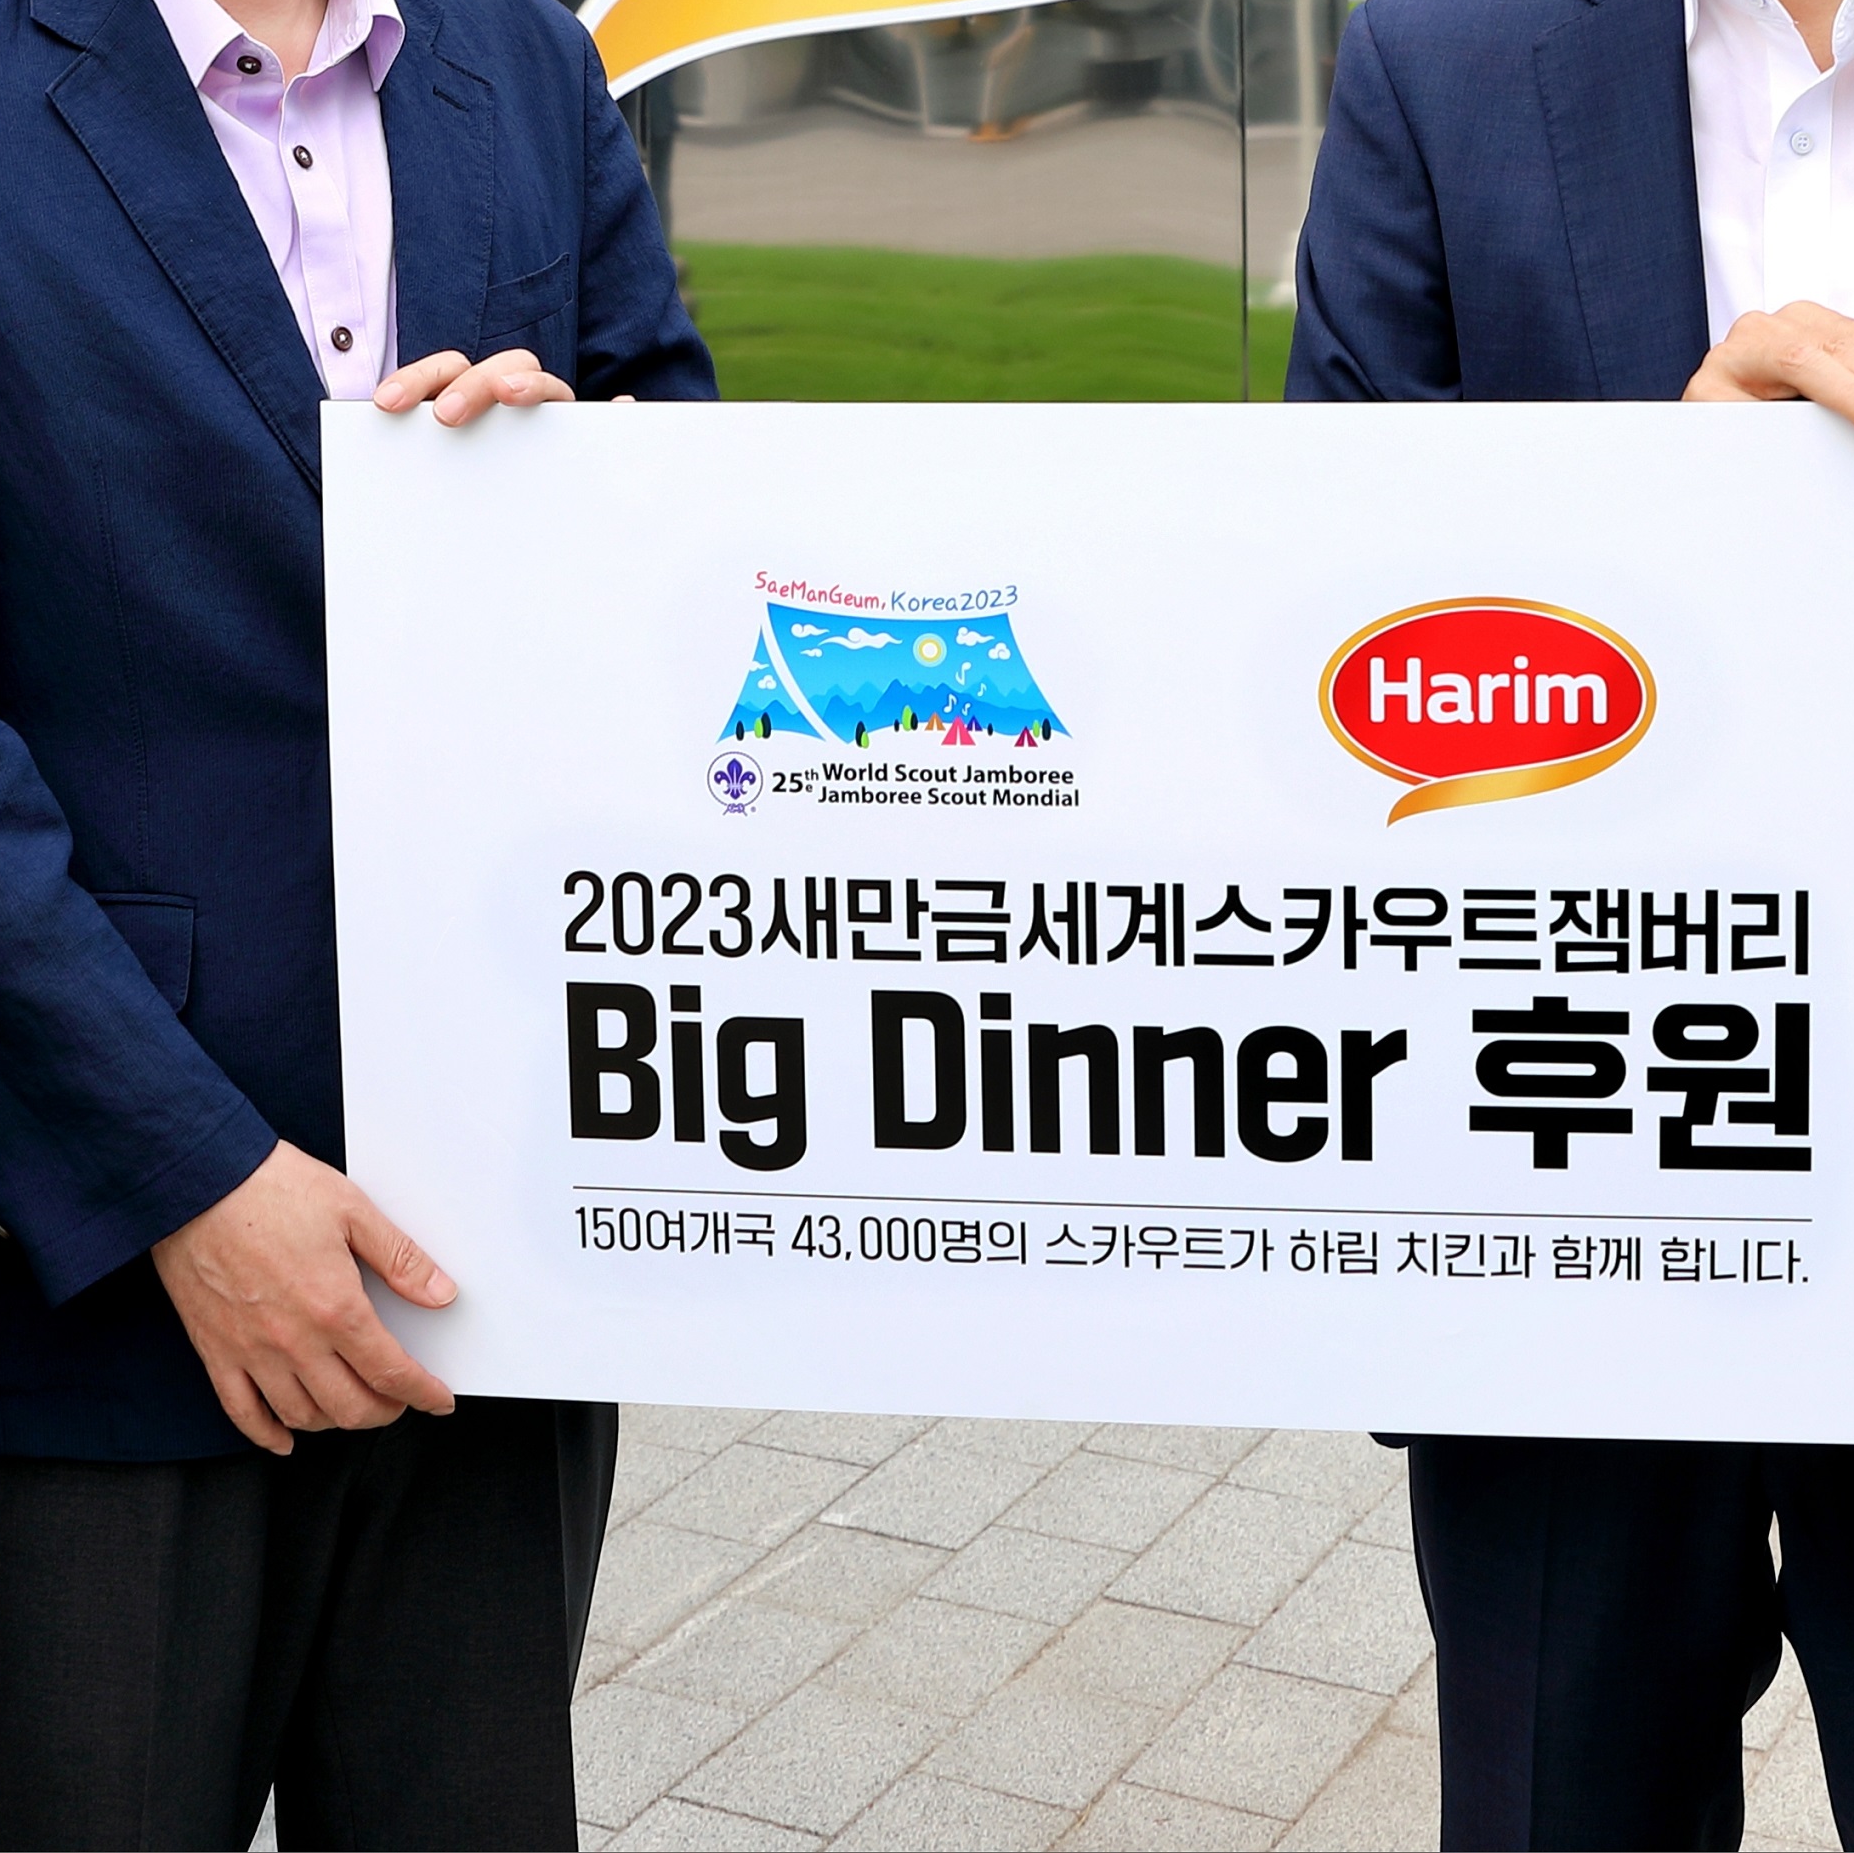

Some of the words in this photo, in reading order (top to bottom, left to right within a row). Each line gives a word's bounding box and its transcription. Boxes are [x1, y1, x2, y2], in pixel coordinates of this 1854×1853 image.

[1369, 655, 1608, 724] Harim
[818, 785, 922, 806] Jamboree
[927, 787, 988, 807] Scout
[992, 788, 1080, 808] Mondial
[821, 762, 888, 782] World
[894, 763, 958, 783] Scout
[962, 764, 1075, 786] Jamboree
[563, 870, 1809, 976] 2023새만금세계스카우트잼버리
[565, 981, 808, 1172] Big
[870, 989, 1408, 1164] Dinner
[1468, 995, 1813, 1172] 후원
[575, 1206, 776, 1257] 150여개국
[791, 1214, 1027, 1265] 43,000명의
[1045, 1223, 1275, 1272] 스카우트가
[1290, 1228, 1378, 1275] 하림
[1396, 1231, 1537, 1279] 치킨과
[1551, 1234, 1641, 1281] 함께
[1660, 1236, 1810, 1284] 합니다.
